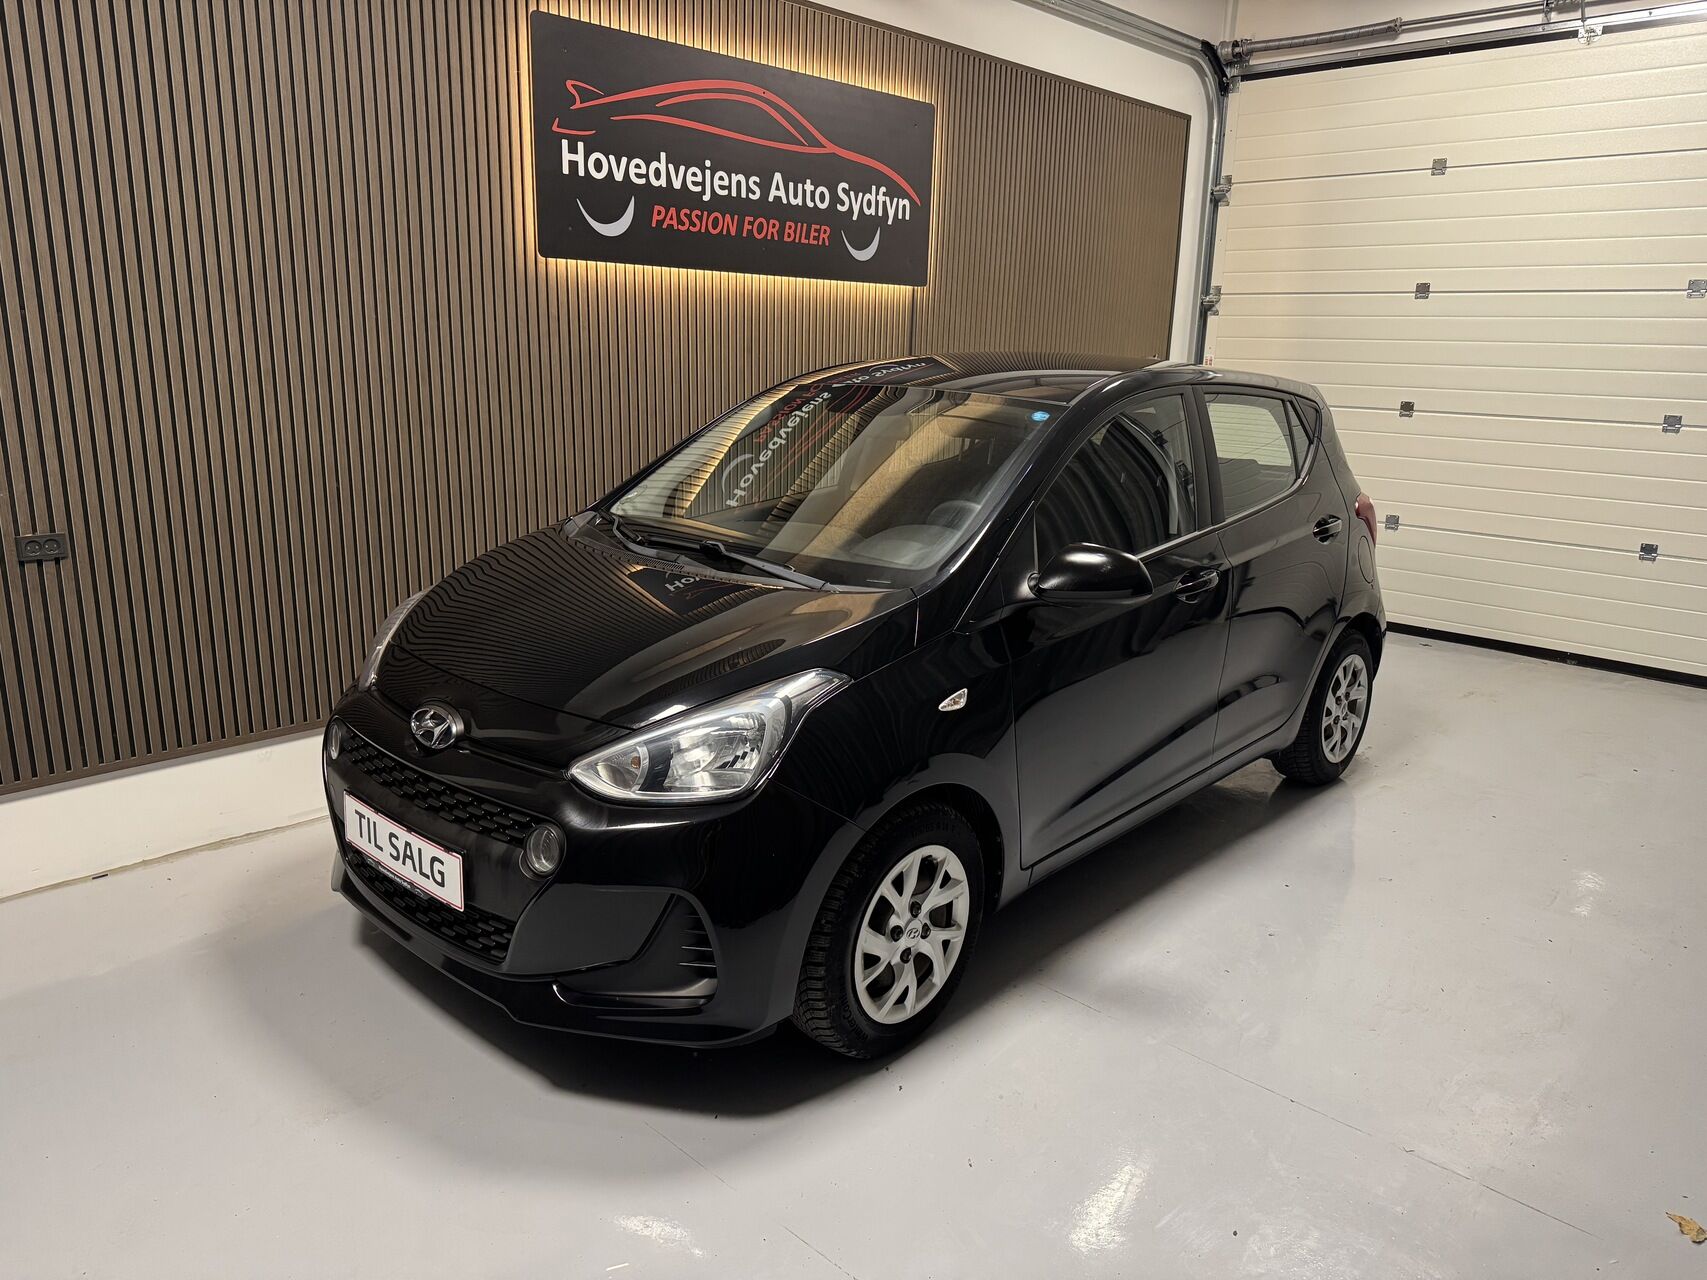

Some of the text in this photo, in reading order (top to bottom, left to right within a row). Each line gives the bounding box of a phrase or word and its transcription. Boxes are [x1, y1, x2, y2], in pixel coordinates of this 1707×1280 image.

[561, 139, 911, 225] Hovedvejens Auto Sydfyn
[651, 205, 831, 246] PASSION FOR BILER
[355, 809, 383, 852] TIL
[388, 832, 445, 888] SALG
